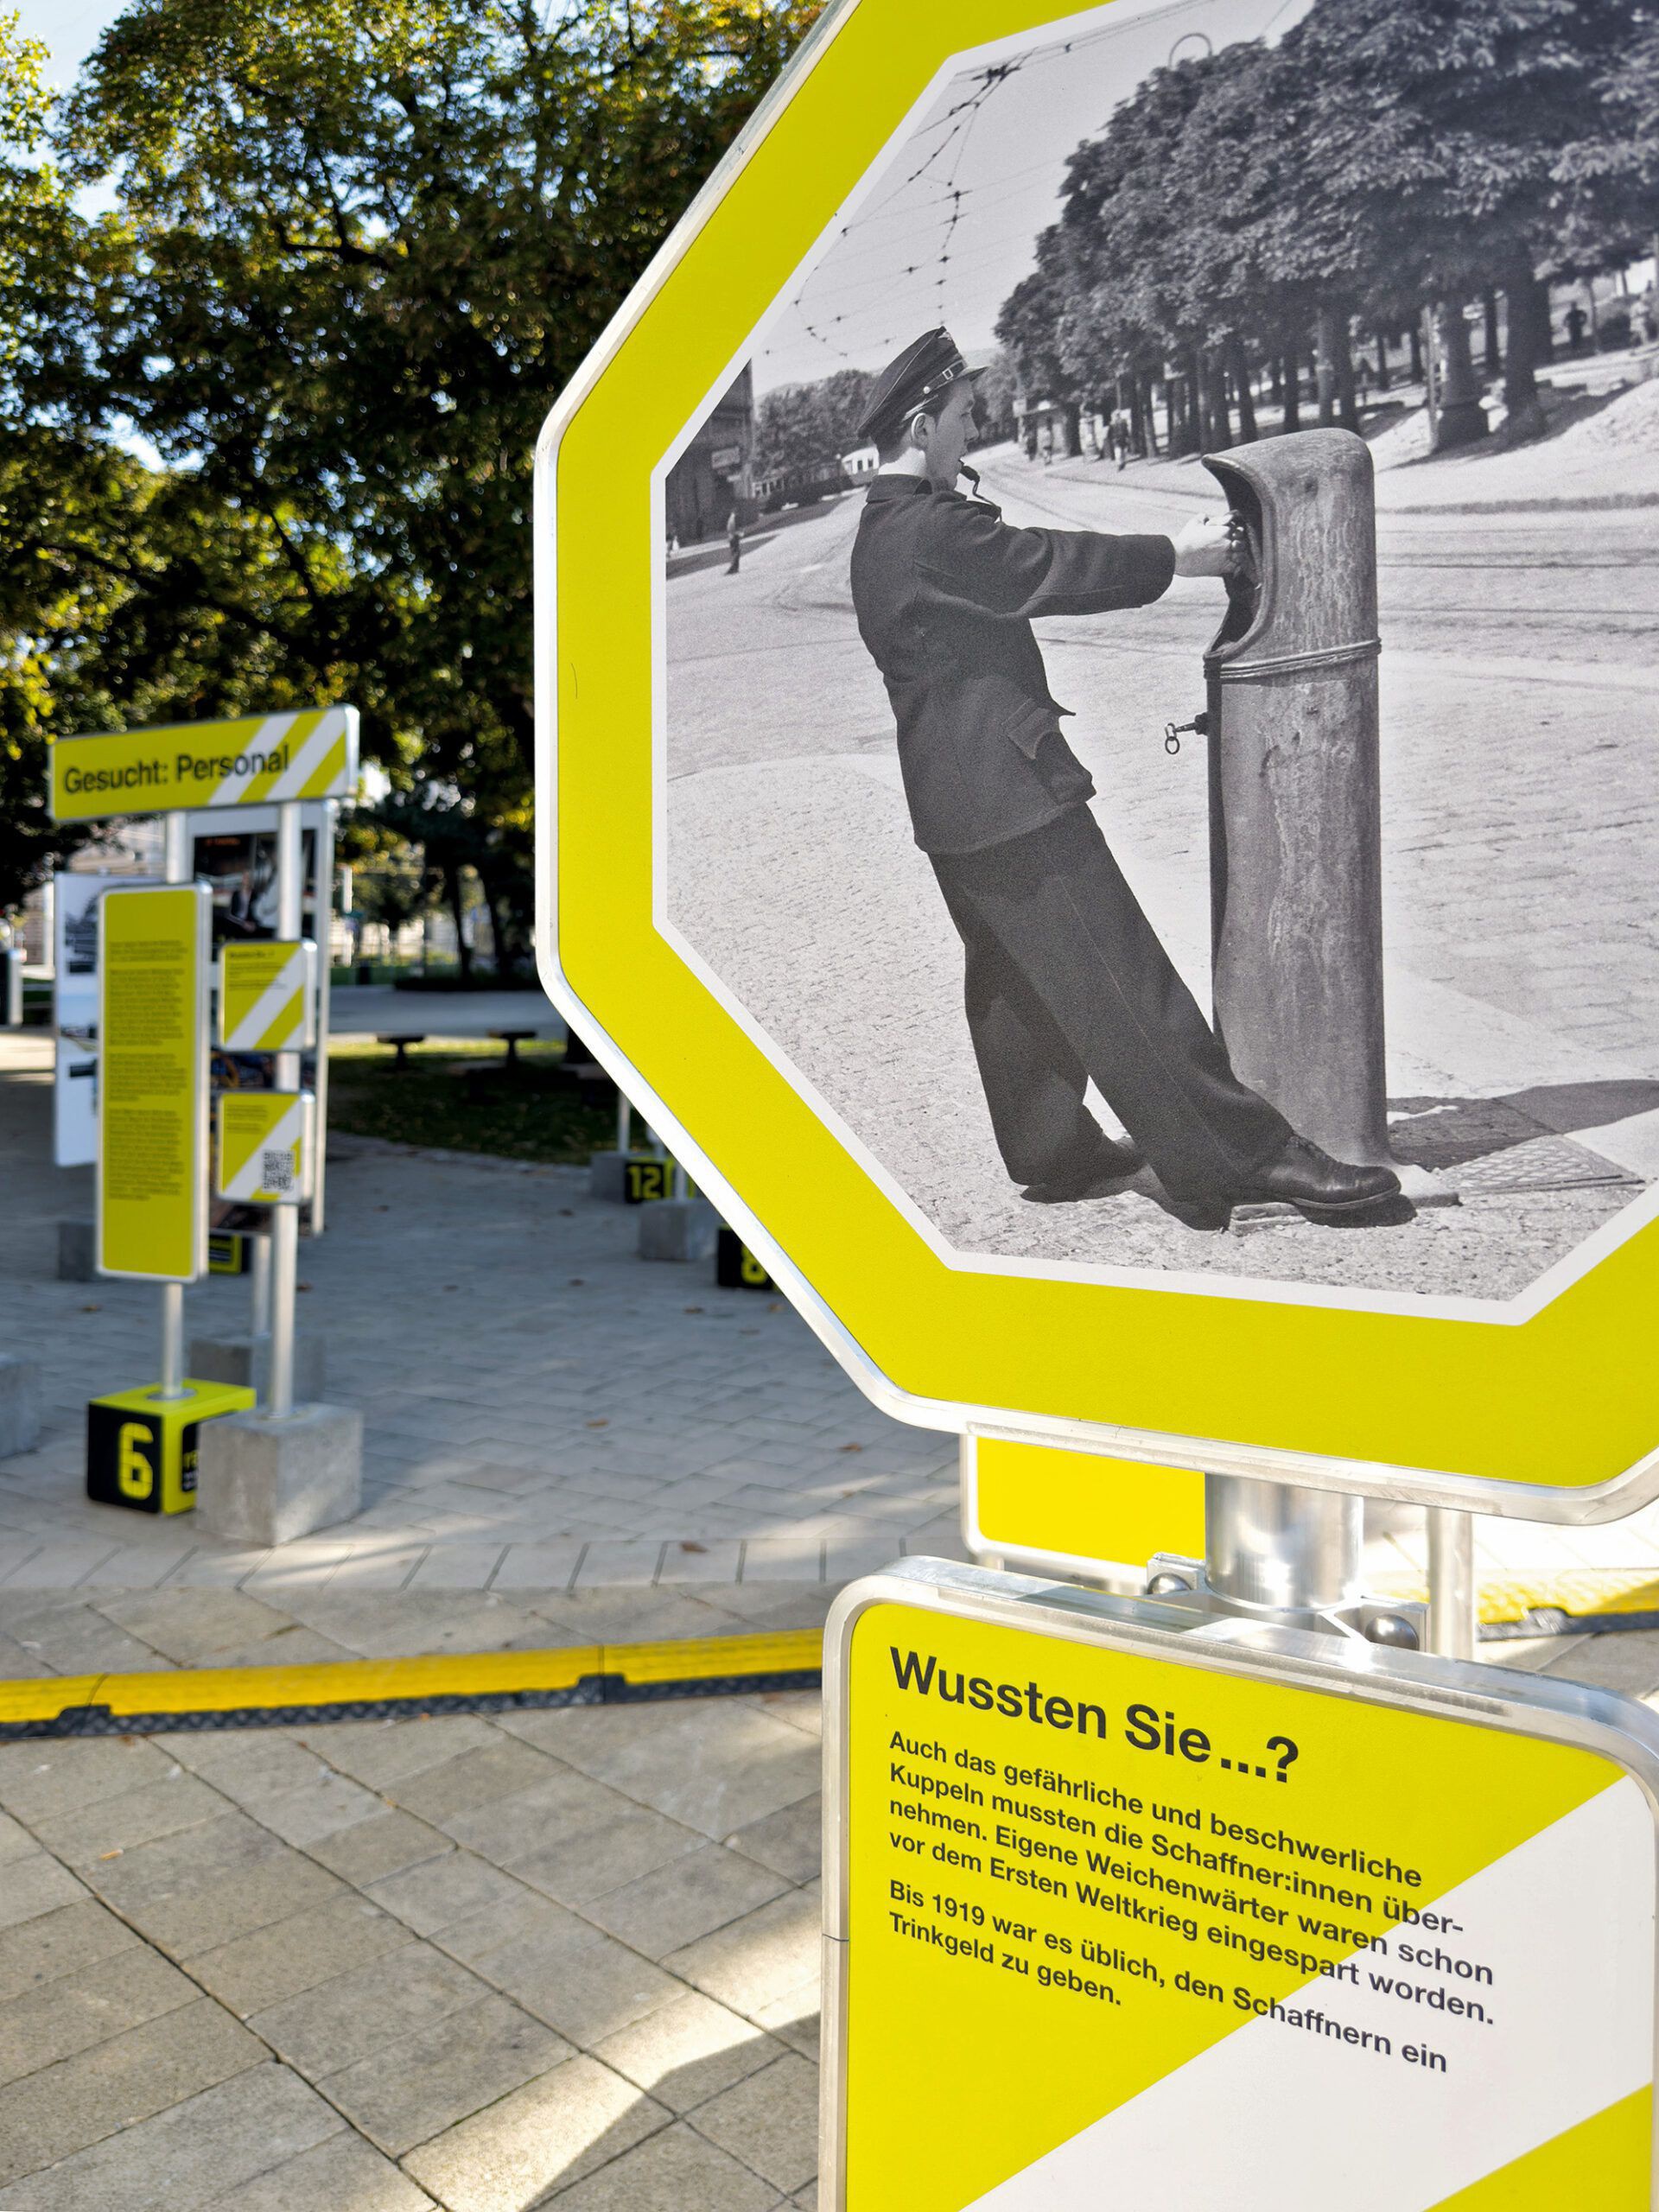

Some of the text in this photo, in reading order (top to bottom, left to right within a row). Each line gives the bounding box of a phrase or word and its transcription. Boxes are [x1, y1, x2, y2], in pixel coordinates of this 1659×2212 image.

[65, 744, 289, 795] Gesucht: Personal
[628, 1166, 661, 1199] 12
[118, 1421, 153, 1500] 6
[890, 1646, 1107, 1739] Wussten
[889, 1731, 1422, 1888] Auch das gefährliche und beschwerliche
[891, 1762, 1464, 1934] Kuppeln mussten die Schaffner:innen über-
[889, 1832, 1493, 2024] vor dem Ersten Weltkrieg eingespart worden.
[890, 1800, 1493, 1986] nehmen. Eigene Weichenwärter waren schon
[889, 1911, 1121, 2005] Trinkgeld zu geben.
[890, 1879, 1446, 2073] Bis 1919 war es üblich, den Schaffnern ein
